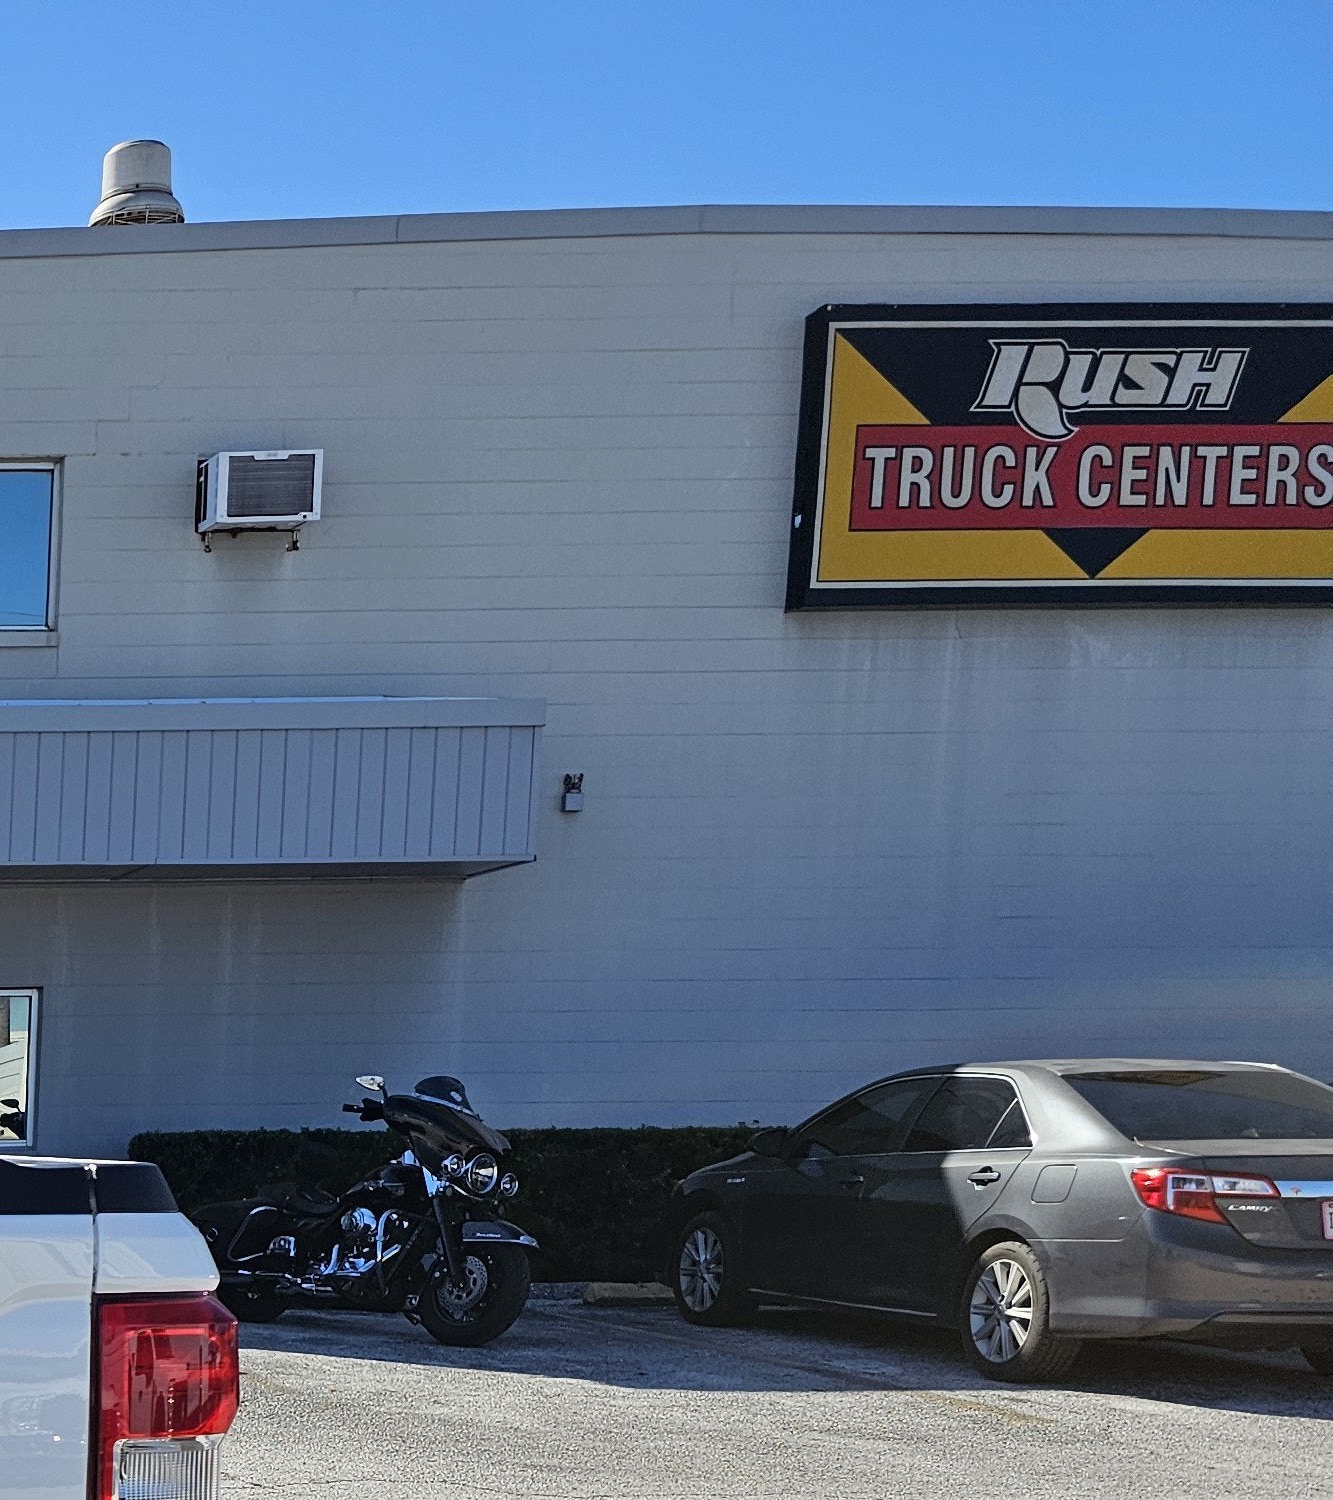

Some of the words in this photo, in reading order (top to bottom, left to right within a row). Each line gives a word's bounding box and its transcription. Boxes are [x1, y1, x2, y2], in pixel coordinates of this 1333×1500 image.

[970, 338, 1251, 442] RUSH
[864, 445, 1058, 509] TRUCK
[1077, 443, 1333, 507] CENTERS
